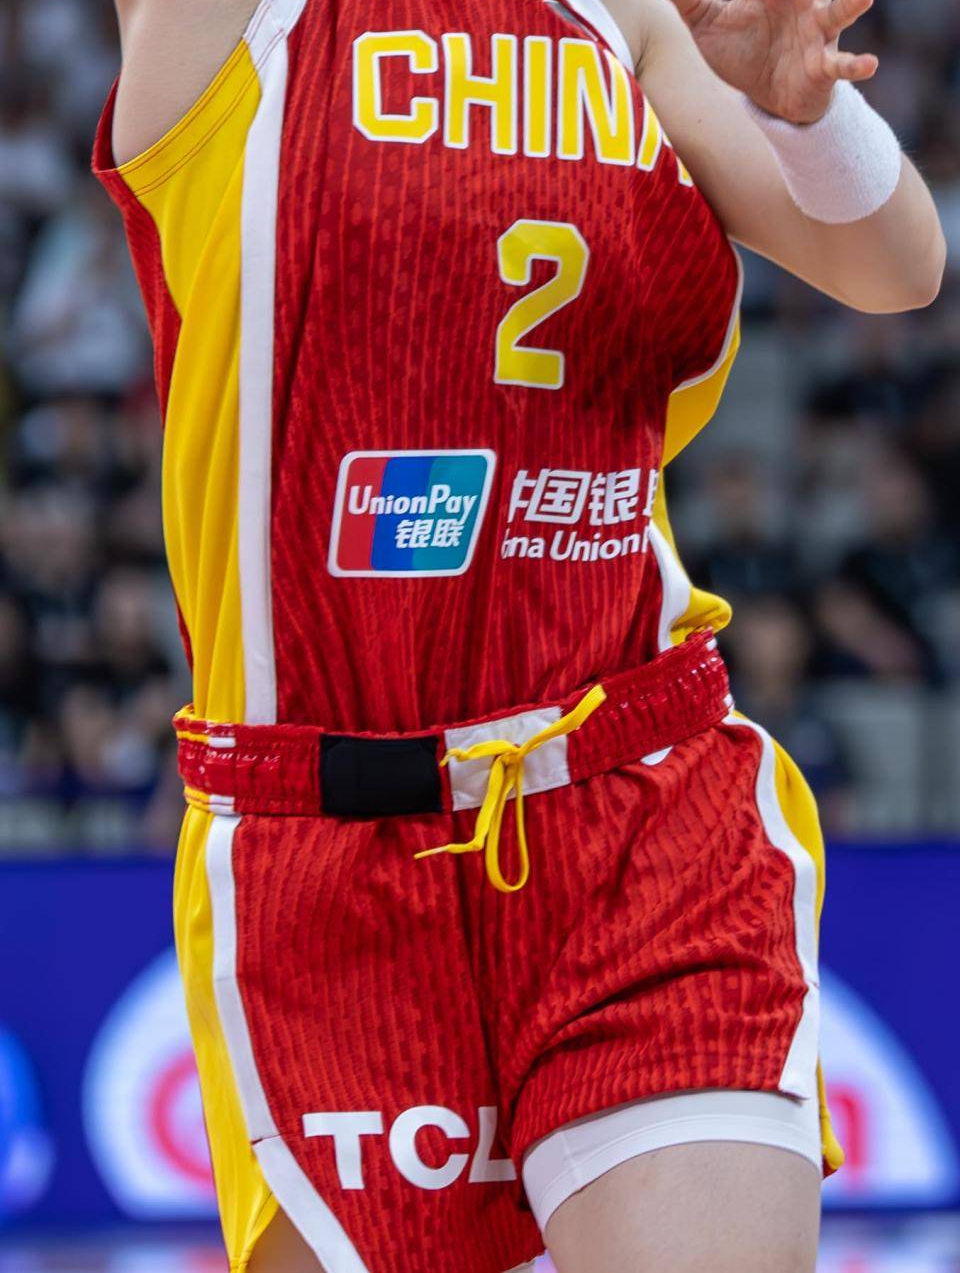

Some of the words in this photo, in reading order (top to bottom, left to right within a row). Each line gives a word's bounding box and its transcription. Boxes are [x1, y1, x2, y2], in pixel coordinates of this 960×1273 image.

[494, 219, 590, 390] 2
[348, 484, 477, 522] UnionPay
[395, 518, 465, 549] 银联
[302, 1105, 517, 1190] TCL
